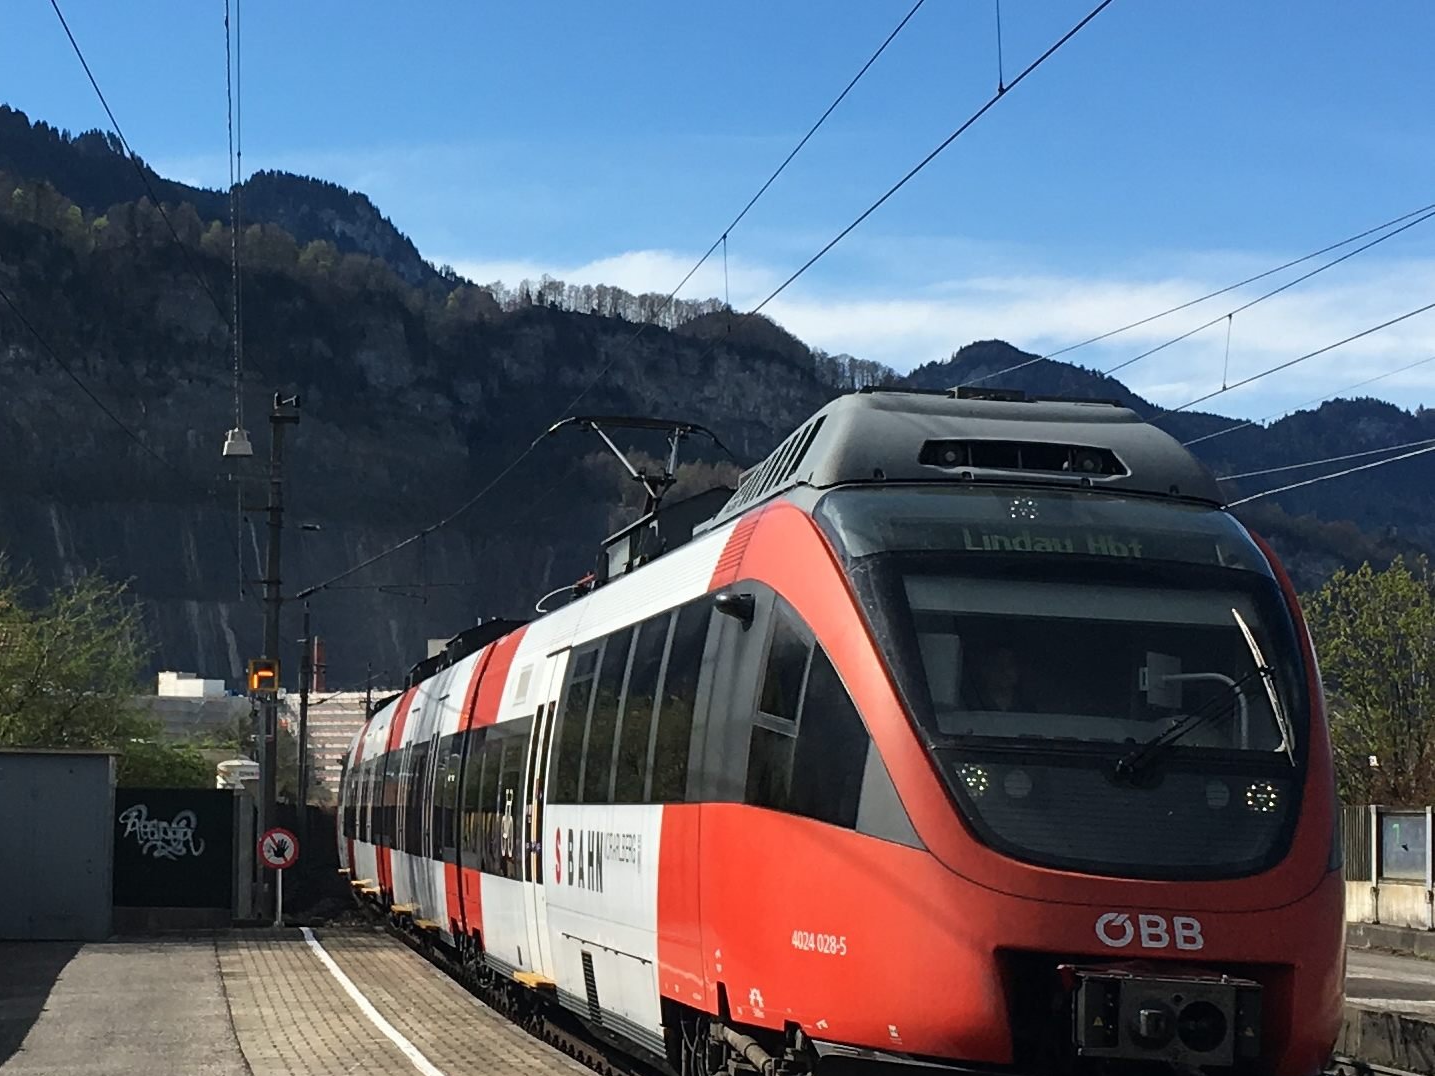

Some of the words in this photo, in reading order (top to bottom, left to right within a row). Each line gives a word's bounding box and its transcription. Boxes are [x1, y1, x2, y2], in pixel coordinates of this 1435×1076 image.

[963, 526, 1074, 554] Lindau
[554, 826, 562, 886] S
[567, 828, 604, 894] BAHN
[791, 930, 815, 952] 4024
[816, 933, 847, 956] 028-5
[1095, 912, 1205, 951] ÖBB
